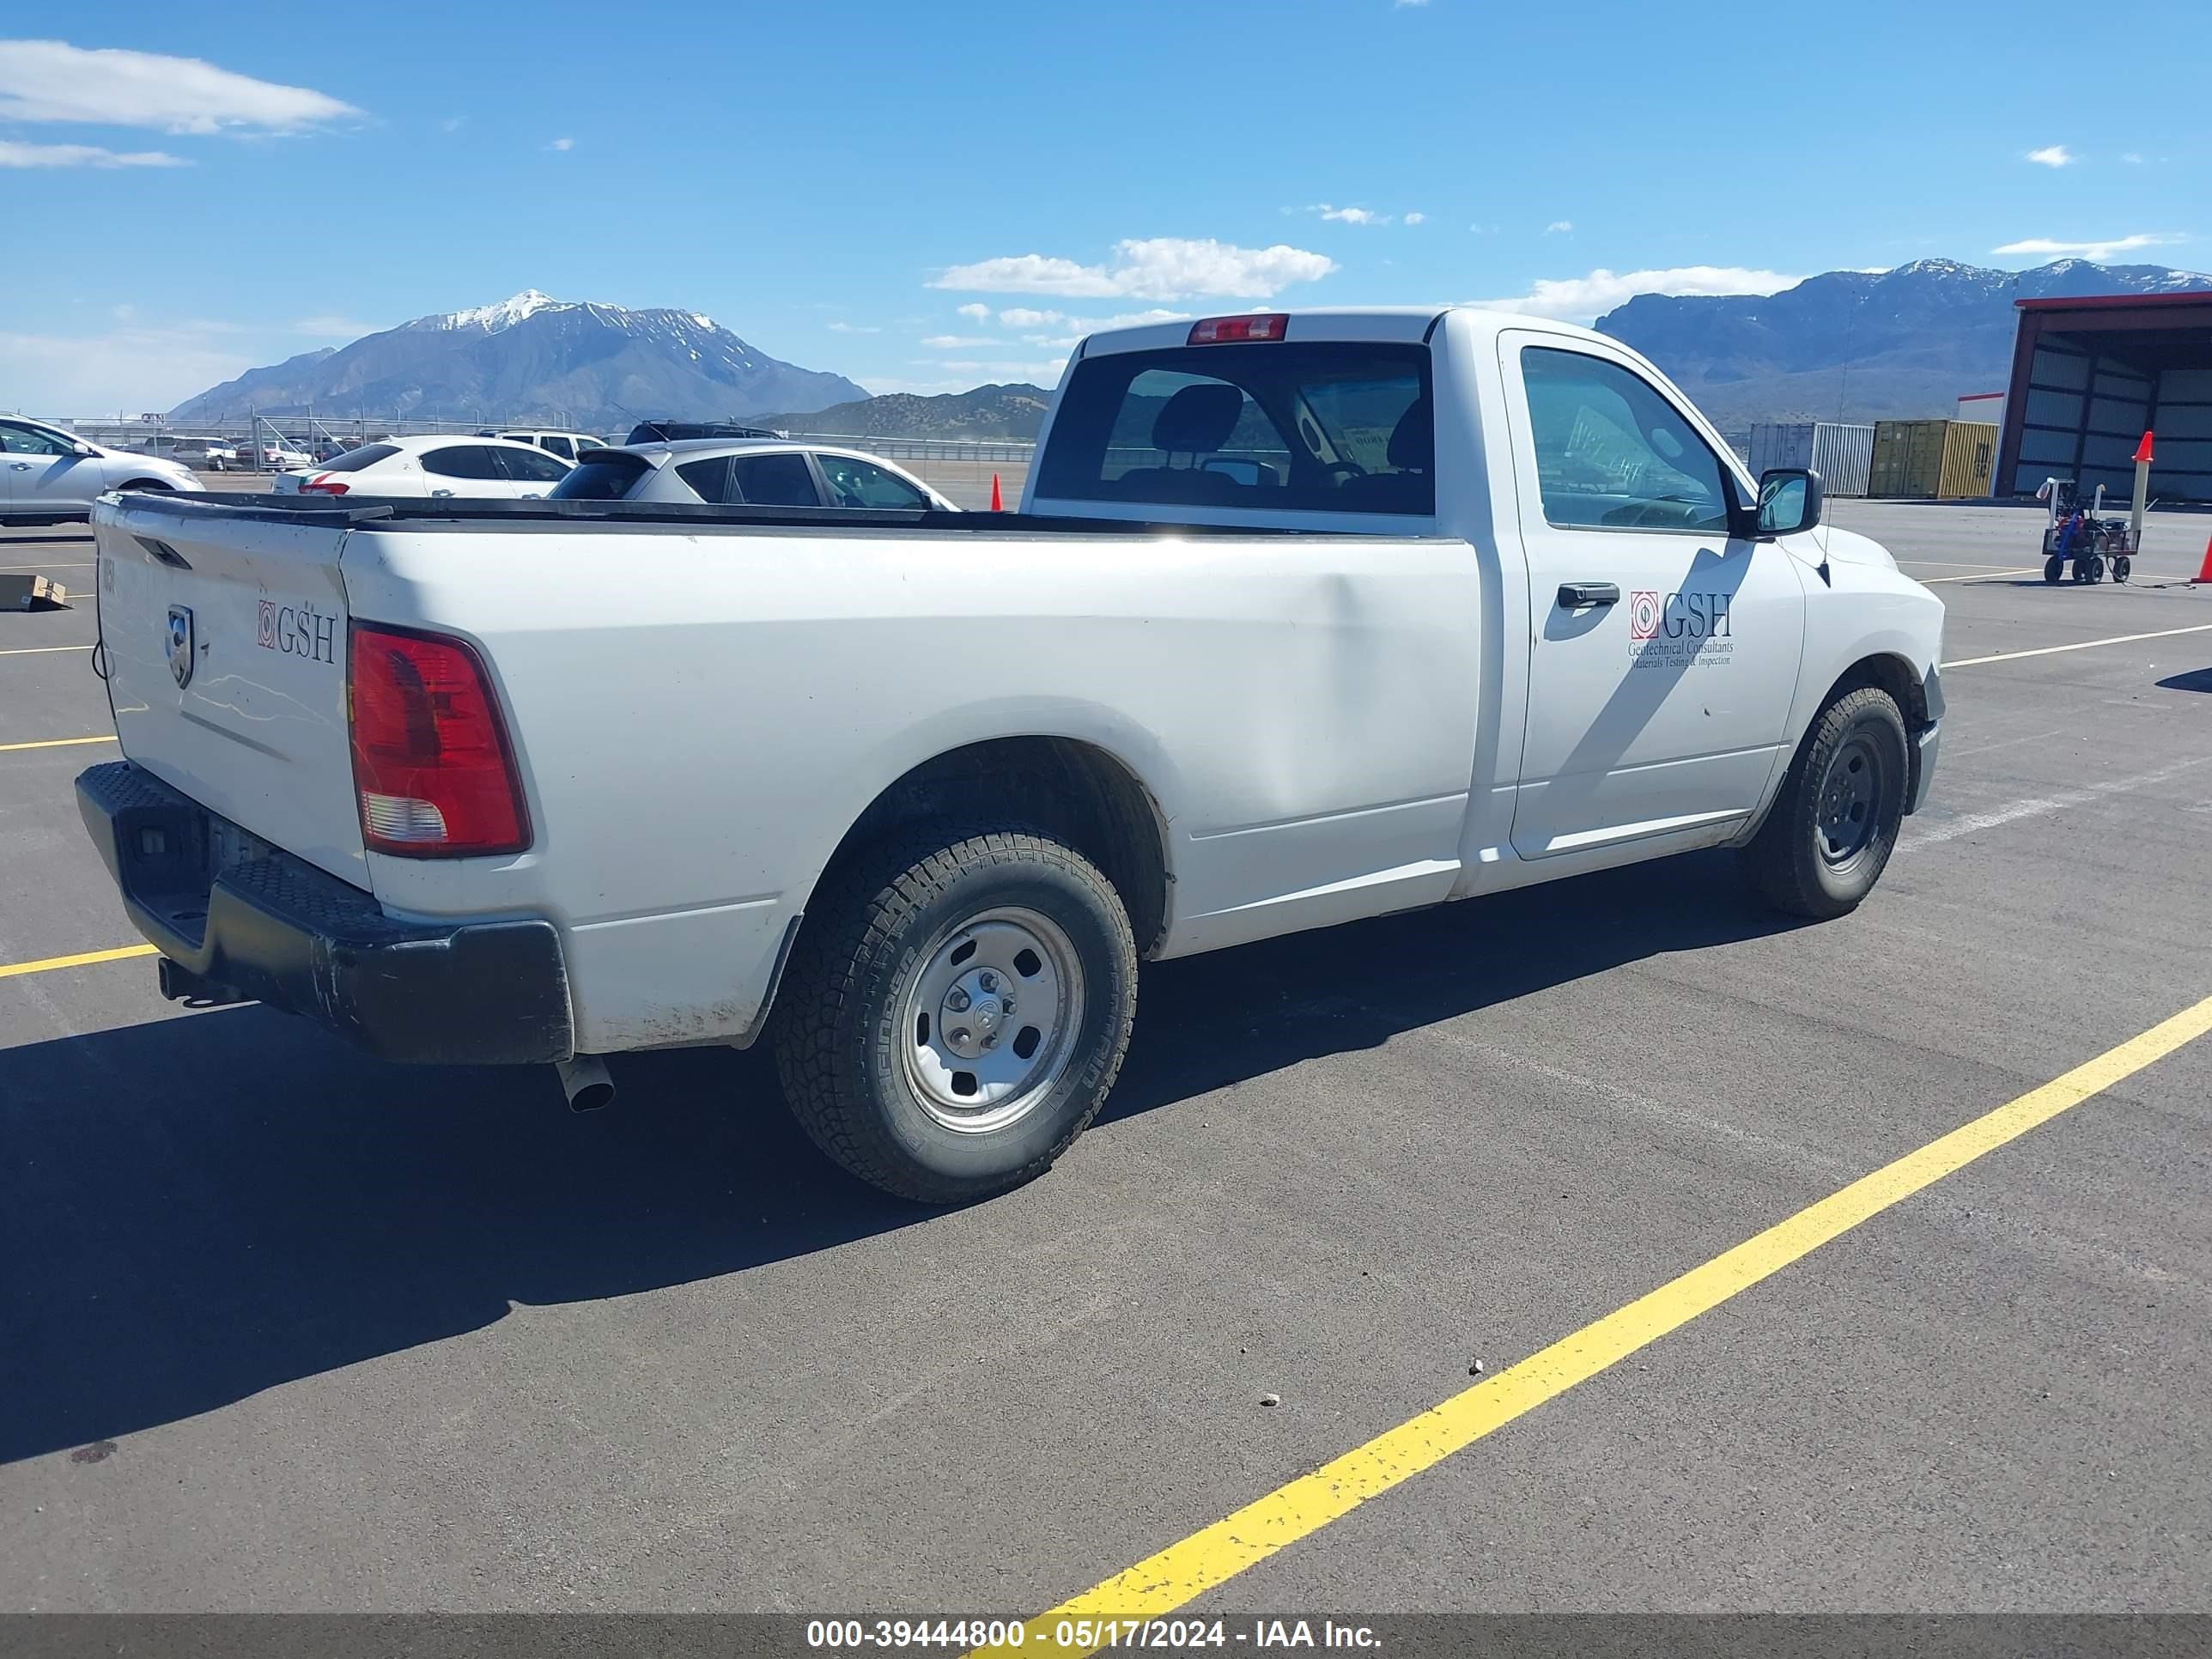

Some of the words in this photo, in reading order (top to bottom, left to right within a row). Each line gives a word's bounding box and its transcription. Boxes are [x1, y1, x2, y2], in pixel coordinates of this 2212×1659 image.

[1662, 592, 1731, 638] GSH
[278, 607, 336, 665] GSH
[1628, 641, 1684, 656] Geotechnical
[1686, 640, 1734, 653] Consultants
[1631, 657, 1663, 670] Materials
[1664, 656, 1689, 668] Testing
[1691, 656, 1696, 666] &
[1698, 656, 1730, 668] Inspection
